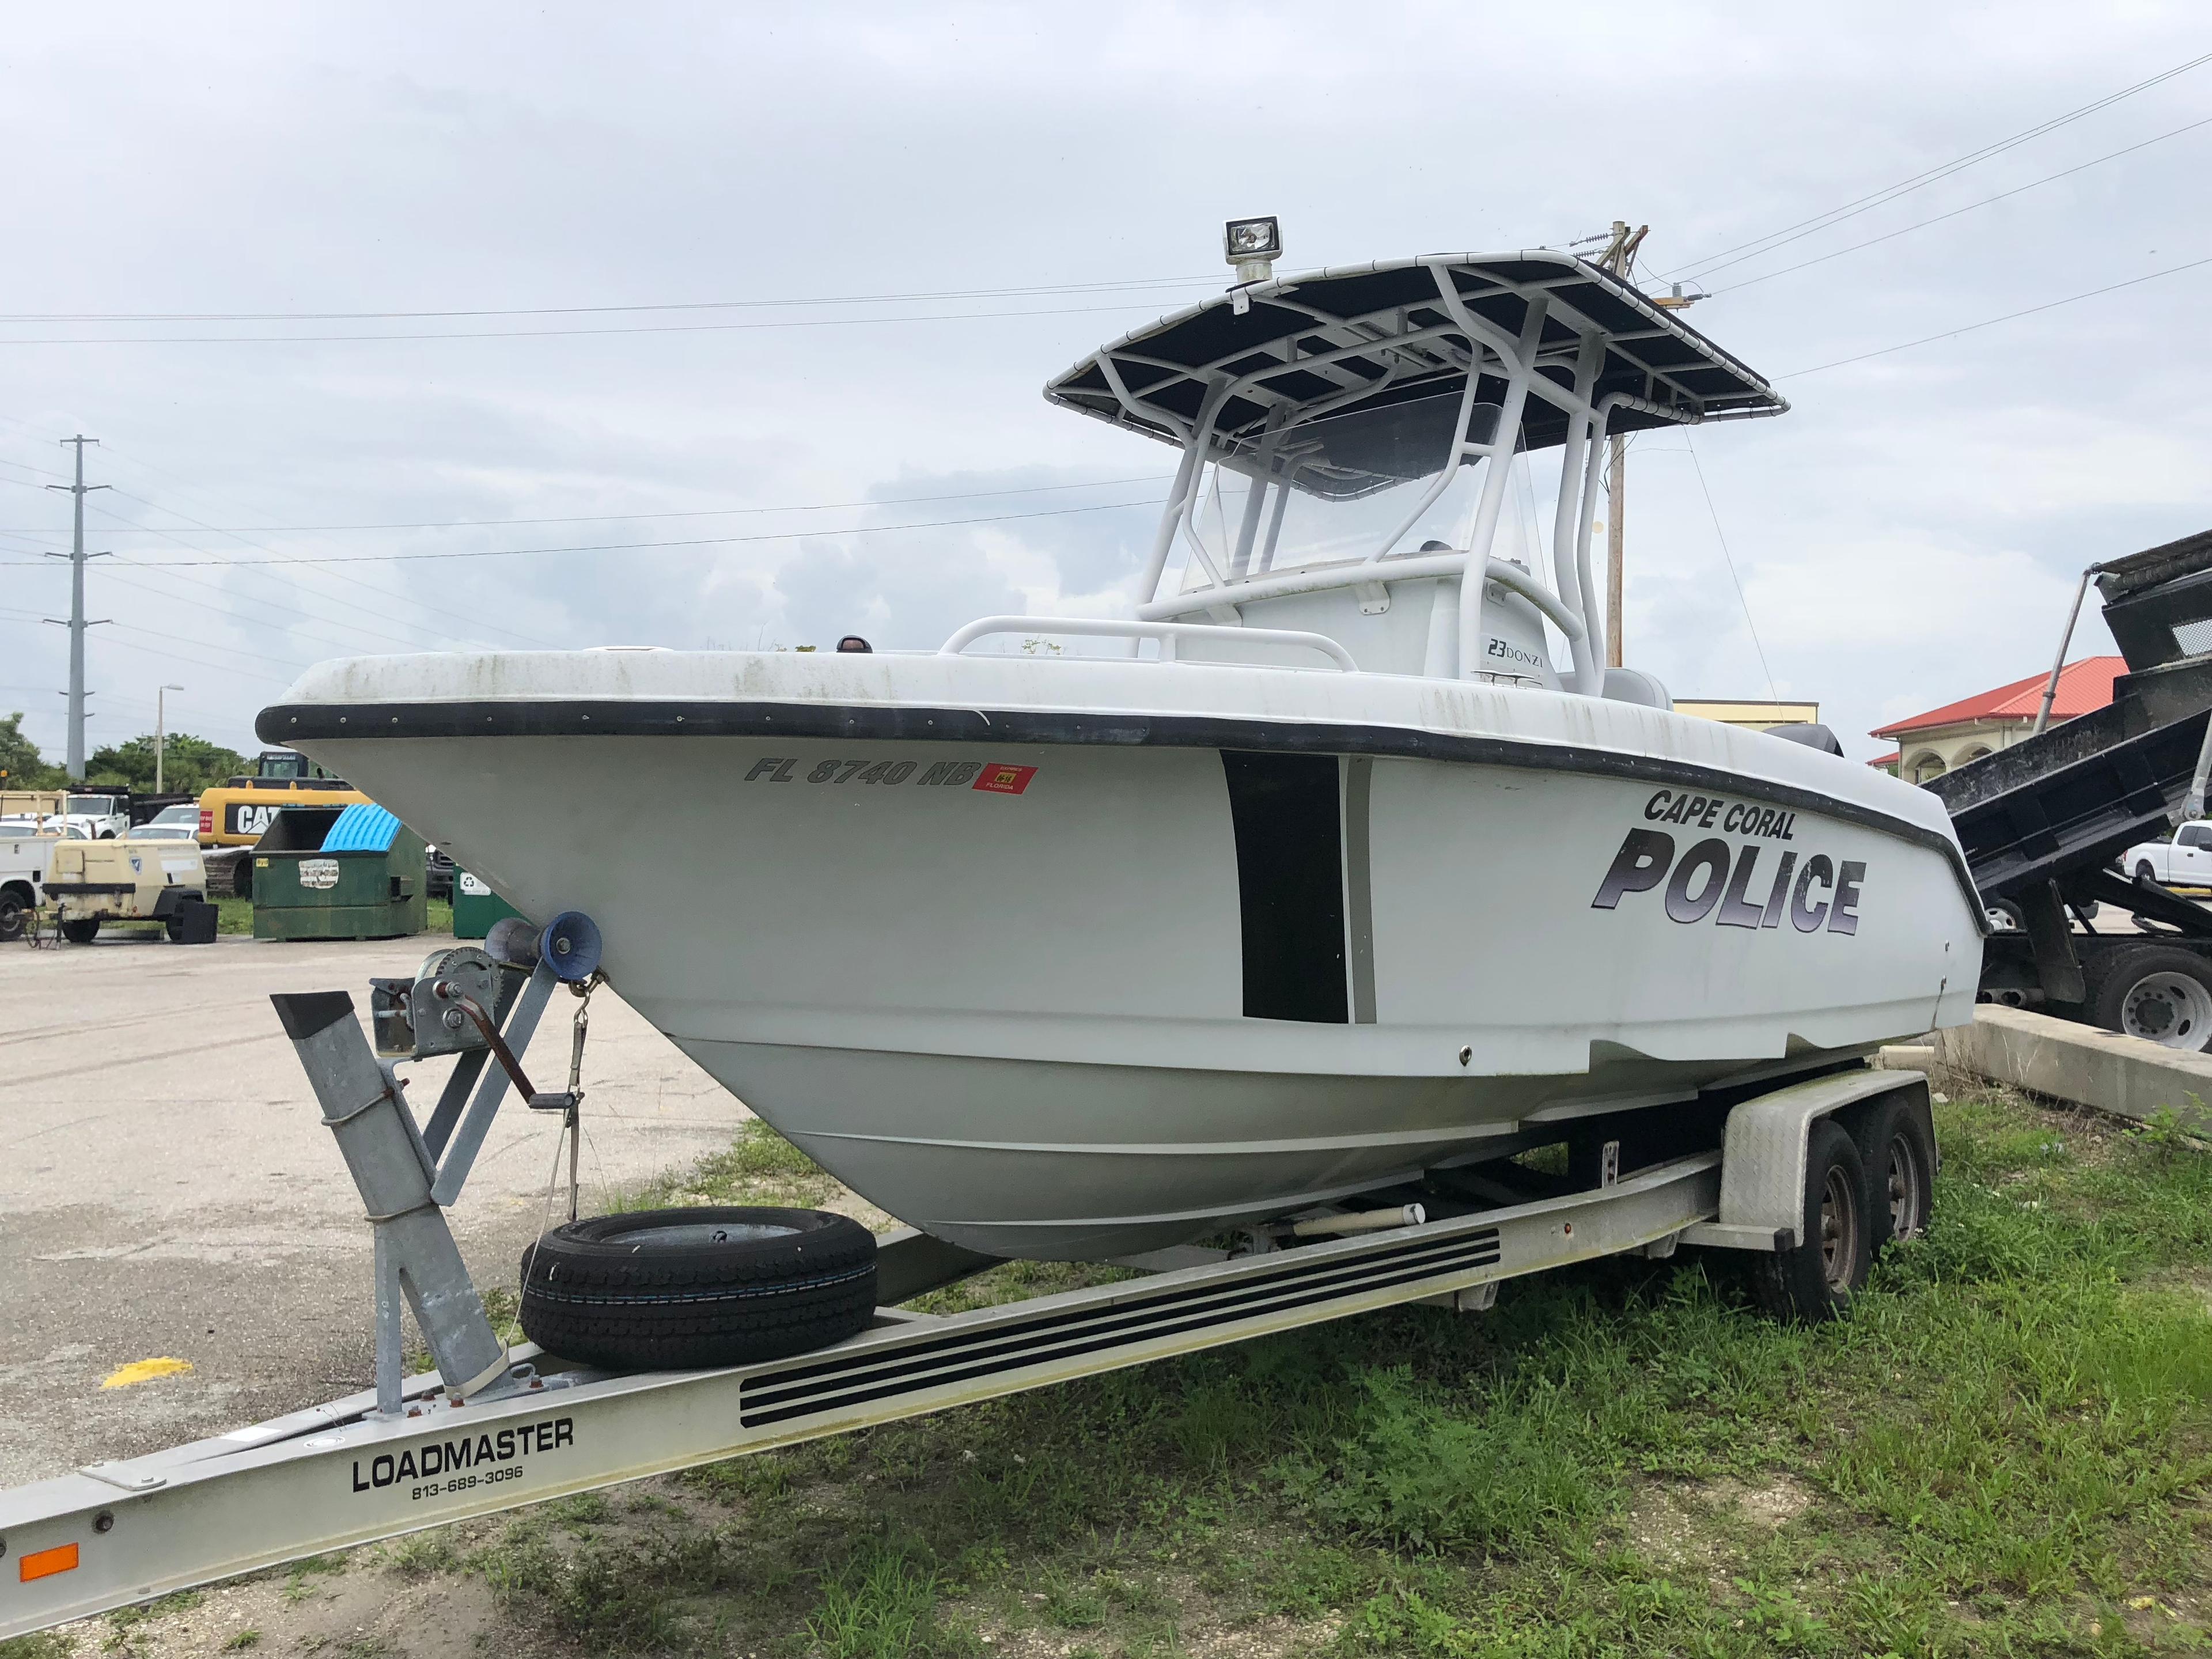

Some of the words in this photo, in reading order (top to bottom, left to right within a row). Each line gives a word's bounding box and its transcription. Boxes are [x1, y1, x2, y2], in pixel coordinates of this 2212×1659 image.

[1488, 638, 1506, 658] 23
[1507, 647, 1543, 668] DONZI
[744, 757, 799, 782] FL
[807, 759, 918, 785] 8740
[919, 762, 982, 786] NB
[1644, 789, 1725, 829] CAPE
[1723, 803, 1796, 840] CORAL
[1590, 827, 1868, 937] POLICE
[353, 1417, 574, 1493] LOADMASTER
[412, 1466, 524, 1500] 813-689-3096
